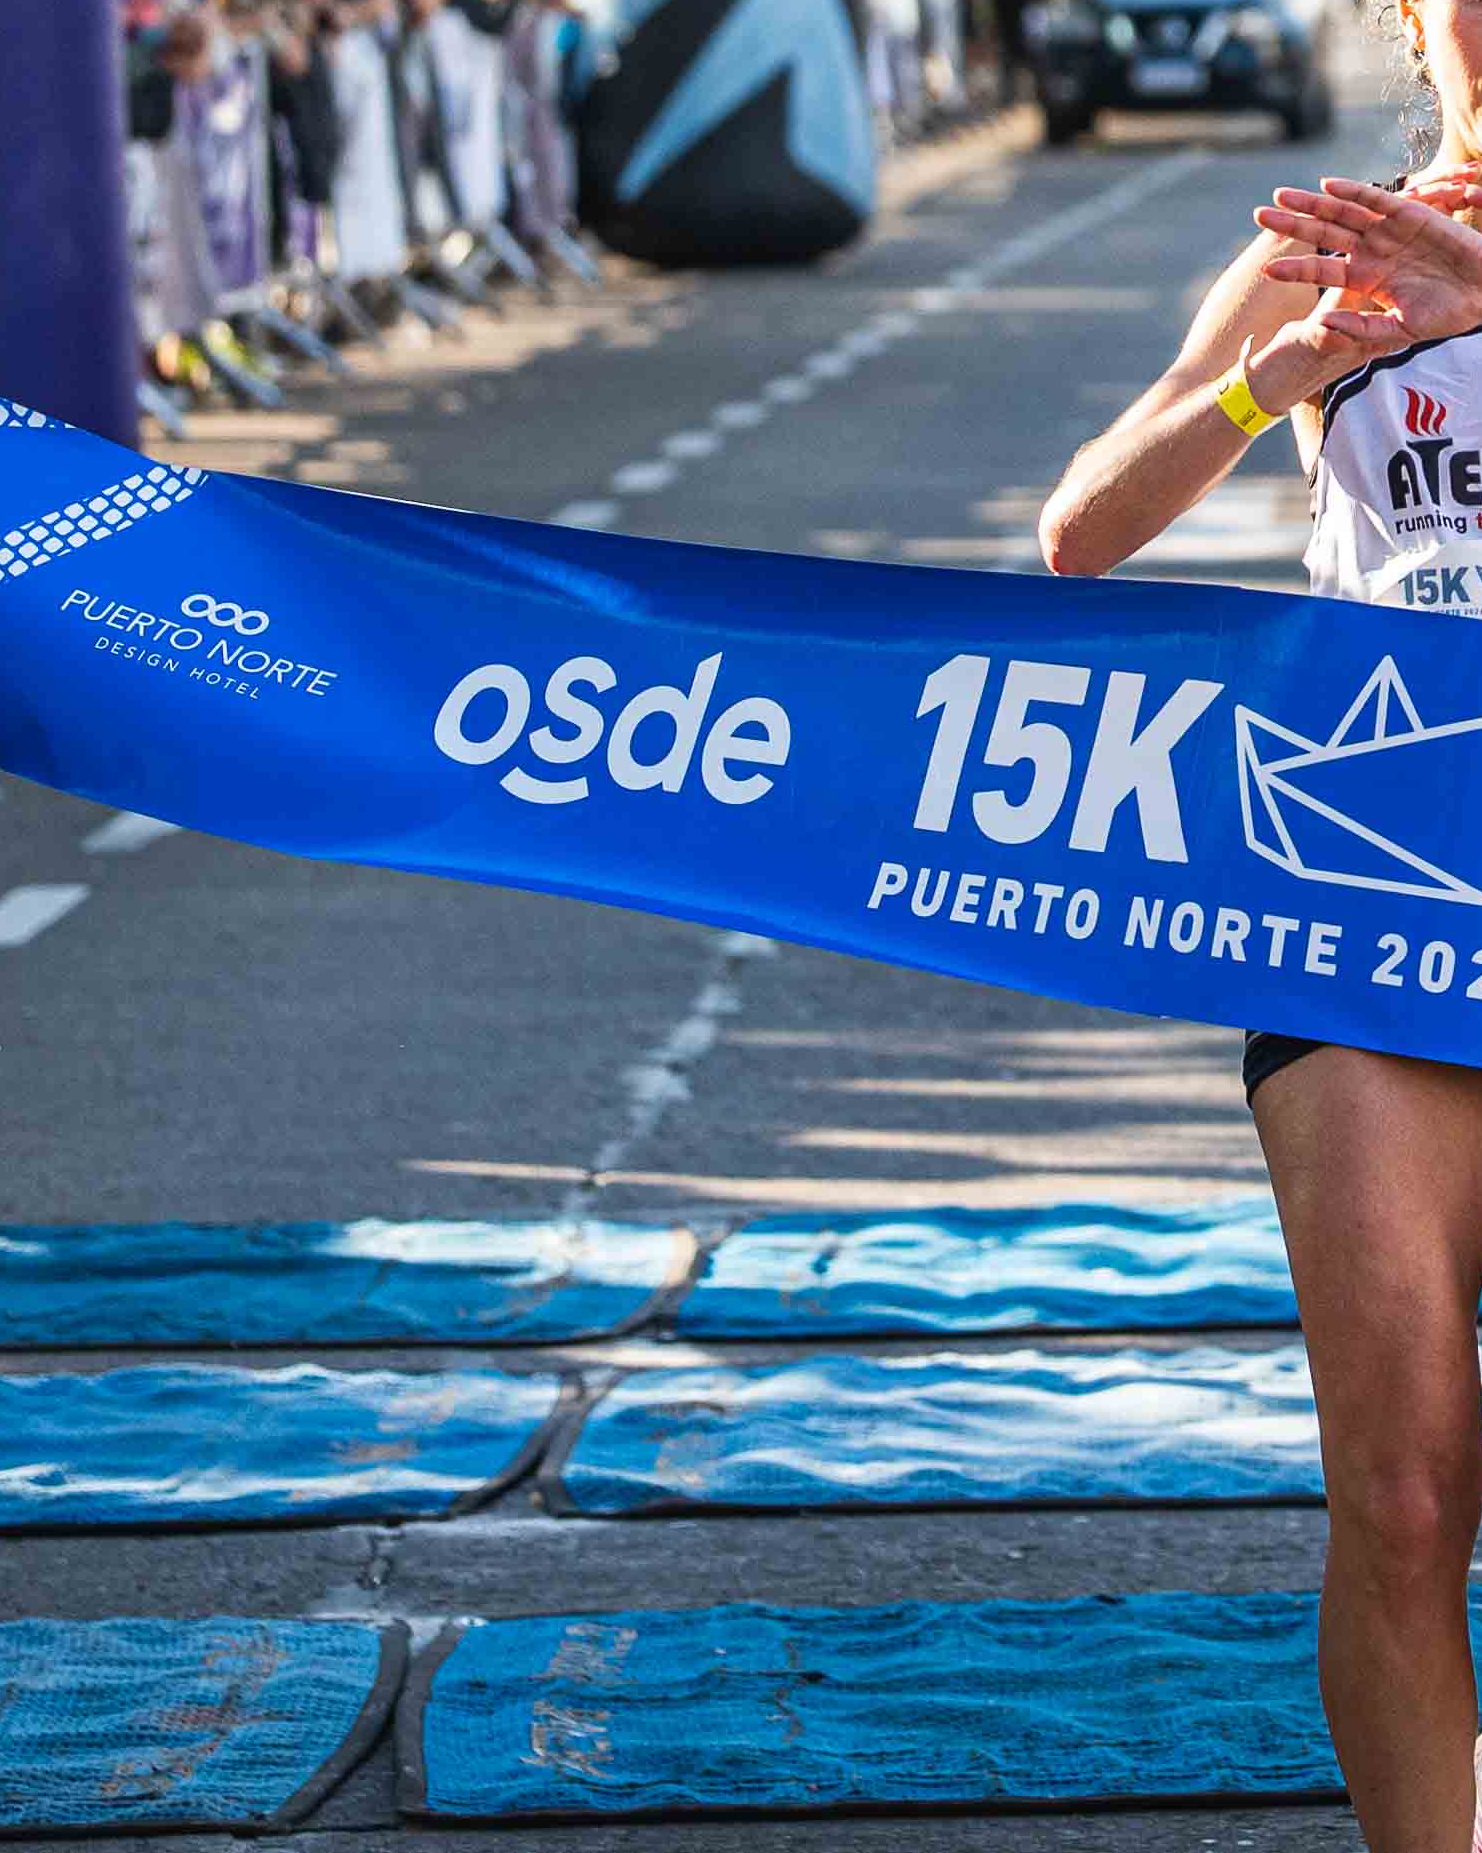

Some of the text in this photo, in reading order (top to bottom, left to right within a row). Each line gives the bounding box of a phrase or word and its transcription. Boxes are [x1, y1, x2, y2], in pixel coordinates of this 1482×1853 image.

[1395, 510, 1467, 534] running
[1398, 566, 1471, 606] 15K
[61, 589, 338, 696] PUERTO NORTE
[94, 636, 261, 699] DESIGN HOTEL
[434, 651, 791, 805] osde
[914, 653, 1225, 863] 15K
[867, 860, 1100, 940] PUERTO
[1124, 895, 1343, 976] NORTE
